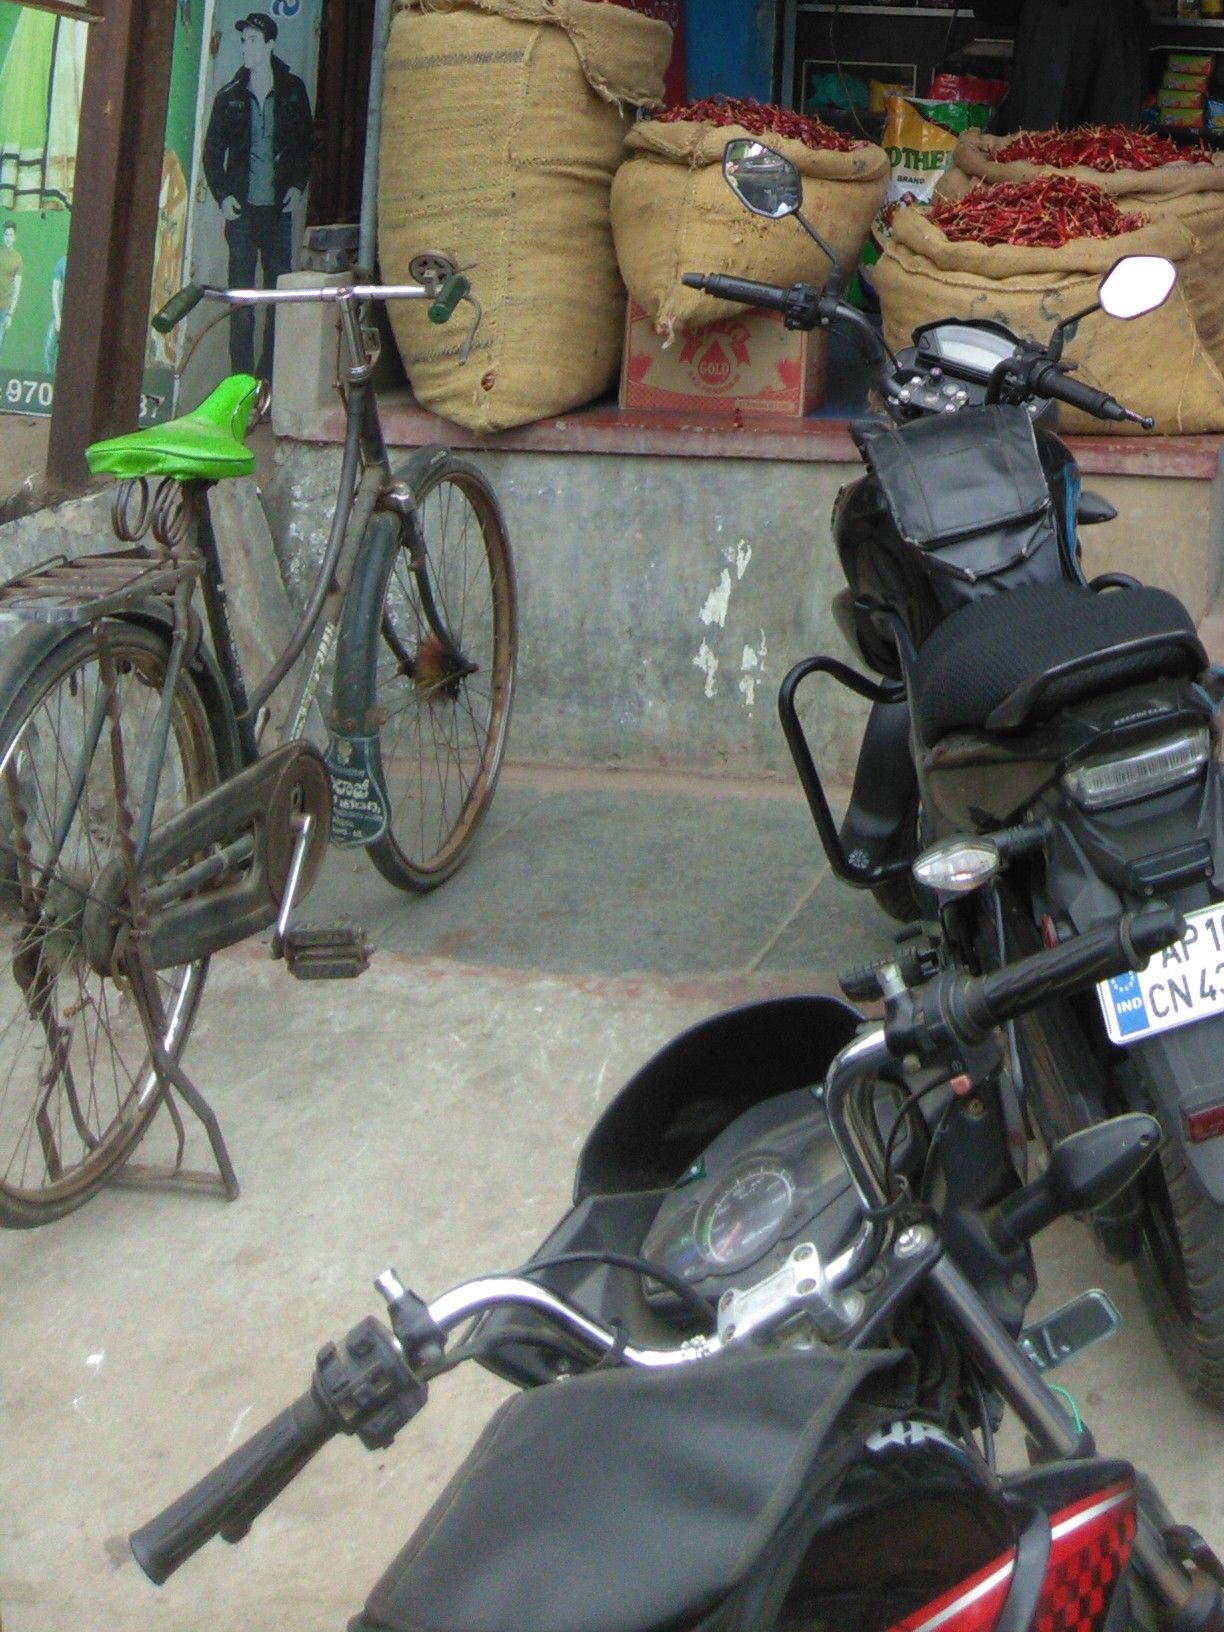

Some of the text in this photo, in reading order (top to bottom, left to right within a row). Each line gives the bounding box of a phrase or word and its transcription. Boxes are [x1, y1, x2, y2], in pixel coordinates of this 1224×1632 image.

[896, 174, 926, 186] BRAND
[1116, 995, 1144, 1016] IND
[1148, 973, 1194, 1019] CN
